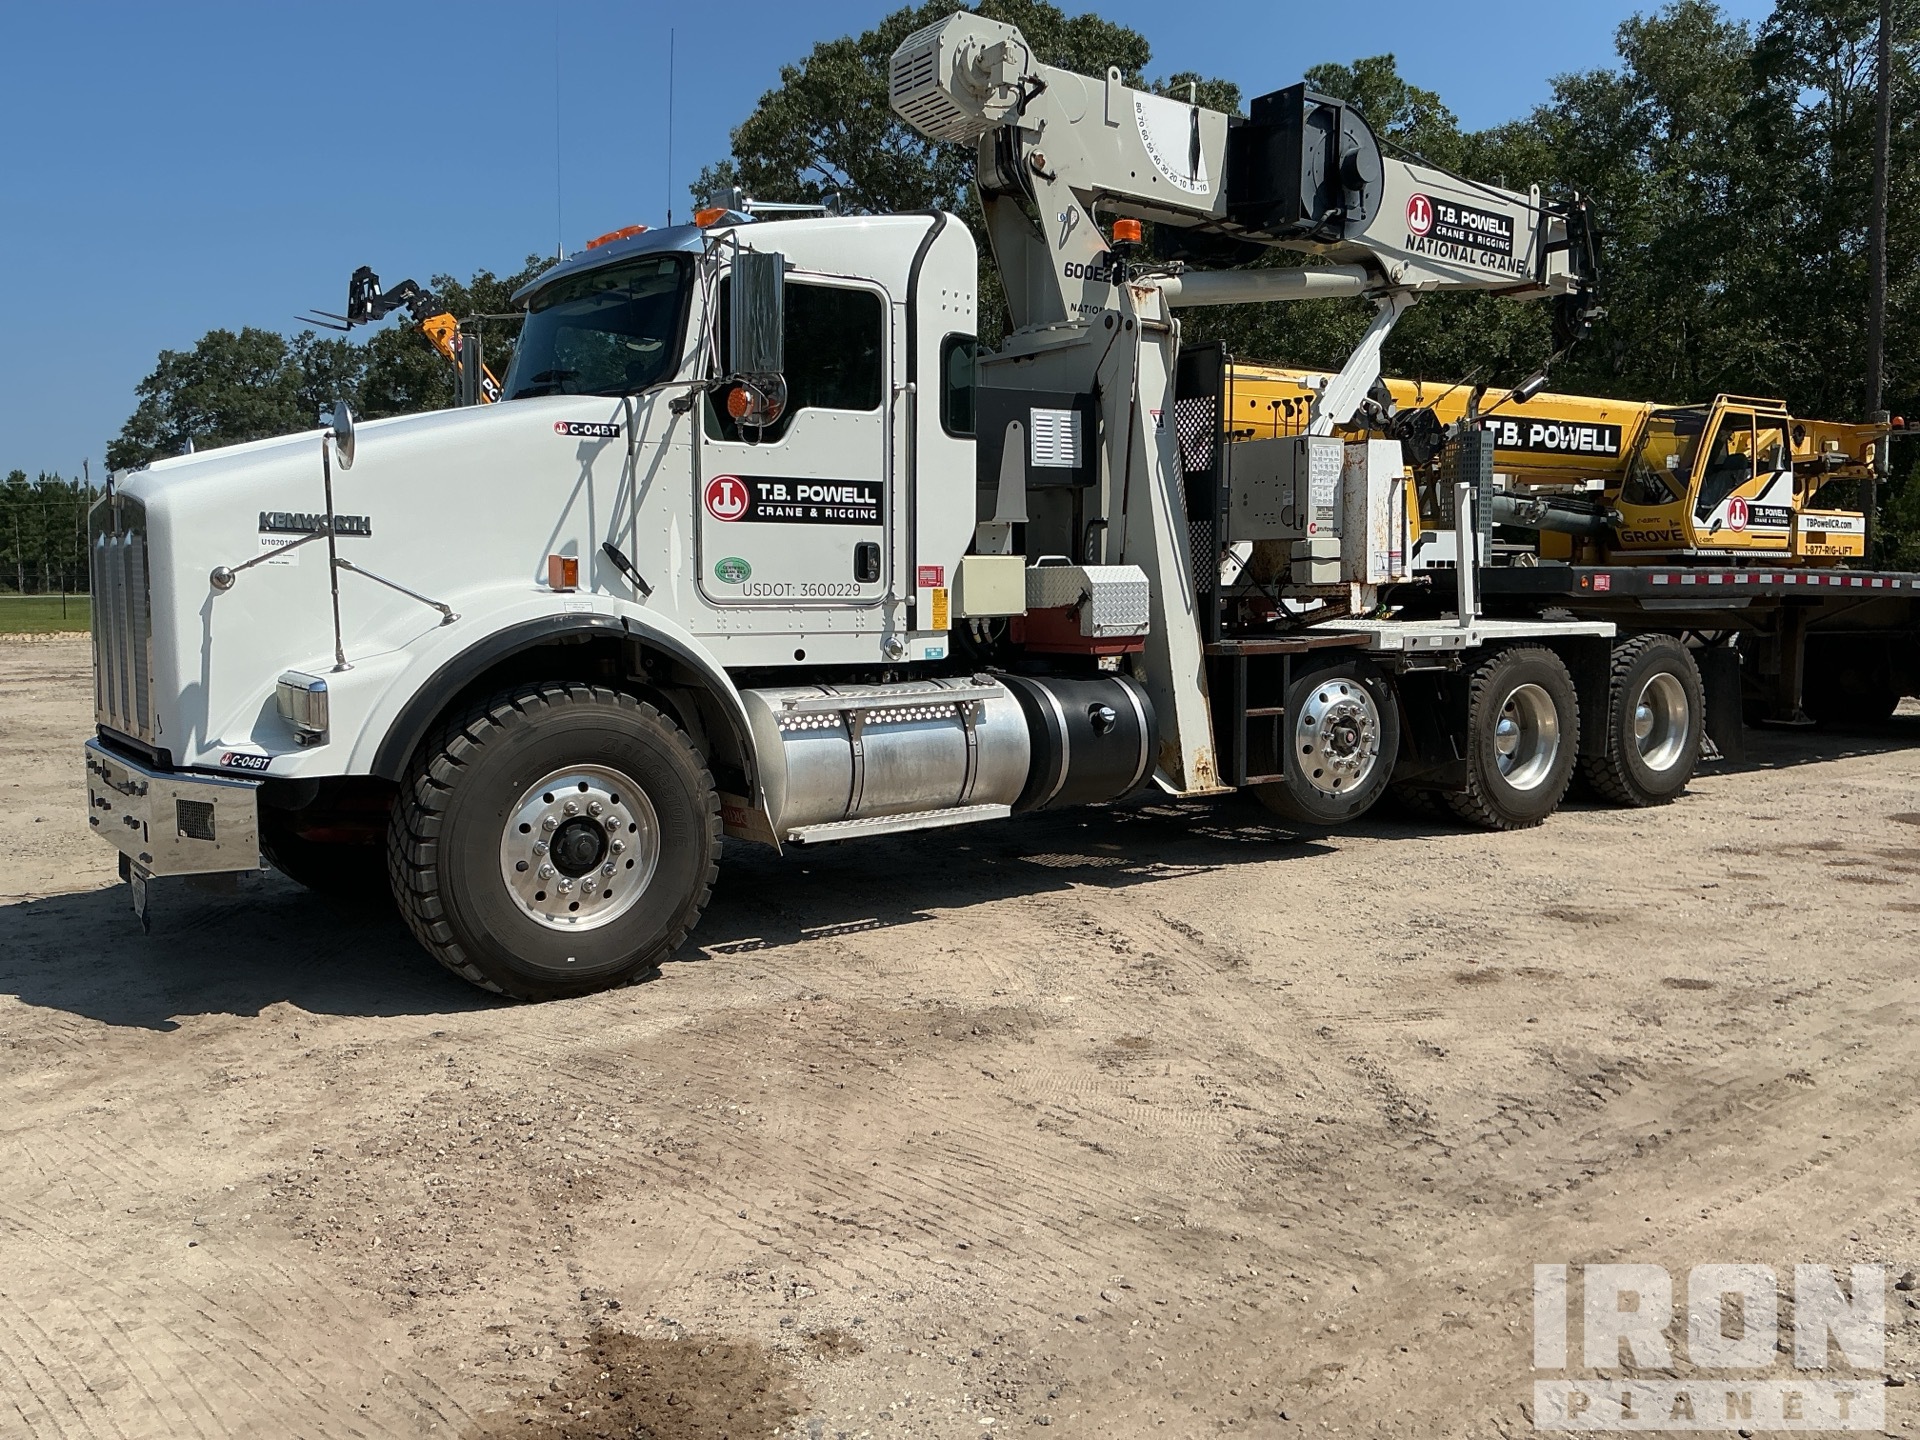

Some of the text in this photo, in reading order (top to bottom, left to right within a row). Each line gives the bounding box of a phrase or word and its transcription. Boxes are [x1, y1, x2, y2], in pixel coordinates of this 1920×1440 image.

[1136, 102, 1142, 113] 80
[1138, 116, 1144, 127] 70
[1141, 129, 1149, 140] 60
[1146, 142, 1154, 153] 50
[1153, 155, 1160, 165] 40
[1161, 164, 1169, 174] 30
[1169, 172, 1177, 182] 20
[1180, 179, 1187, 188] 10
[1437, 205, 1510, 236] T.B. POWELL
[1436, 226, 1465, 240] CRANE
[1477, 236, 1510, 250] RIGGING
[1405, 234, 1525, 275] NATIONAL CRANE
[569, 424, 617, 436] C-04BT
[1485, 420, 1617, 452] T.B. POWELL
[757, 483, 877, 504] T.B. POWELL
[757, 506, 877, 519] CRANE & RIGGING
[1765, 508, 1788, 517] POWELL
[1806, 518, 1852, 529] TBPowellCR.com
[1621, 529, 1685, 543] GROVE
[1805, 545, 1852, 555] 1-877-RIG-LIFT
[742, 583, 861, 597] USDOT: 3600229
[231, 755, 269, 769] C-04BT
